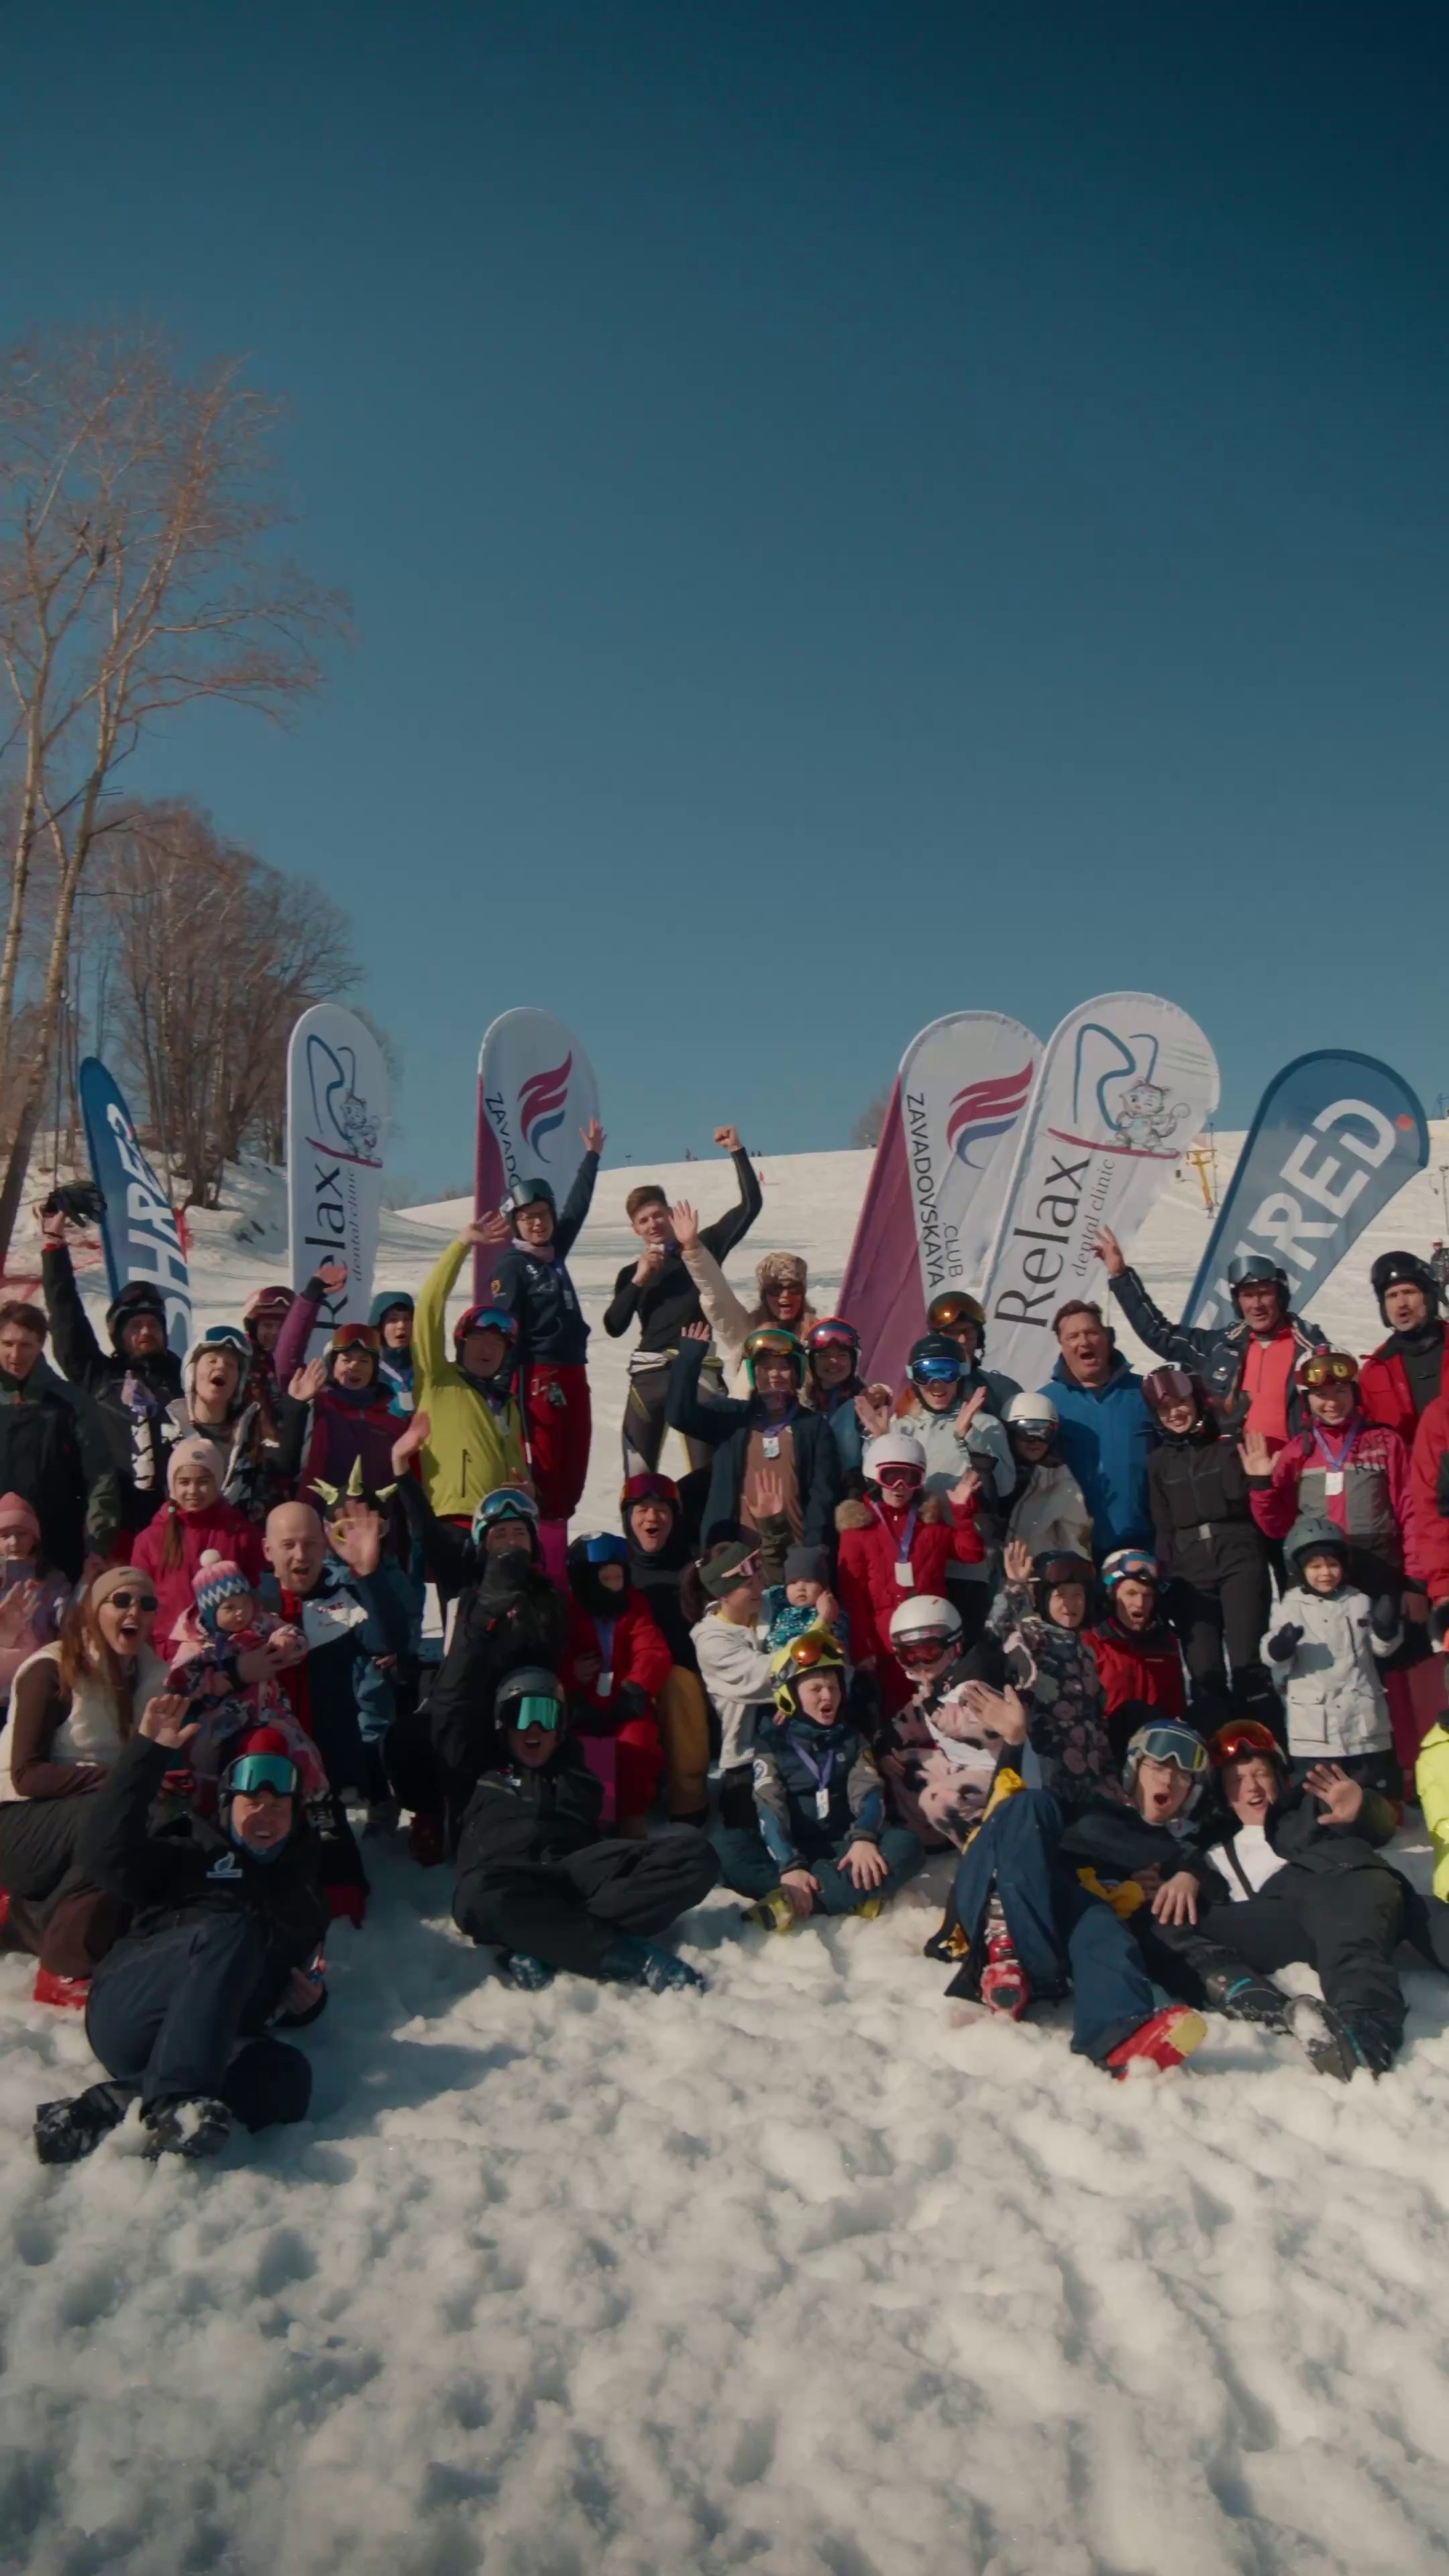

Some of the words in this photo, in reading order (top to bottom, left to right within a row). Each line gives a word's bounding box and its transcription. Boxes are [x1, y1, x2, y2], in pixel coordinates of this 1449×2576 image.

[349, 1220, 362, 1281] dental
[906, 1093, 945, 1288] ZAVADOVSKAYA
[943, 1225, 964, 1278] CLUB
[994, 1154, 1090, 1328] Relax
[1071, 1215, 1100, 1277] dental
[1089, 1159, 1115, 1212] clinic
[1194, 1098, 1397, 1331] RED
